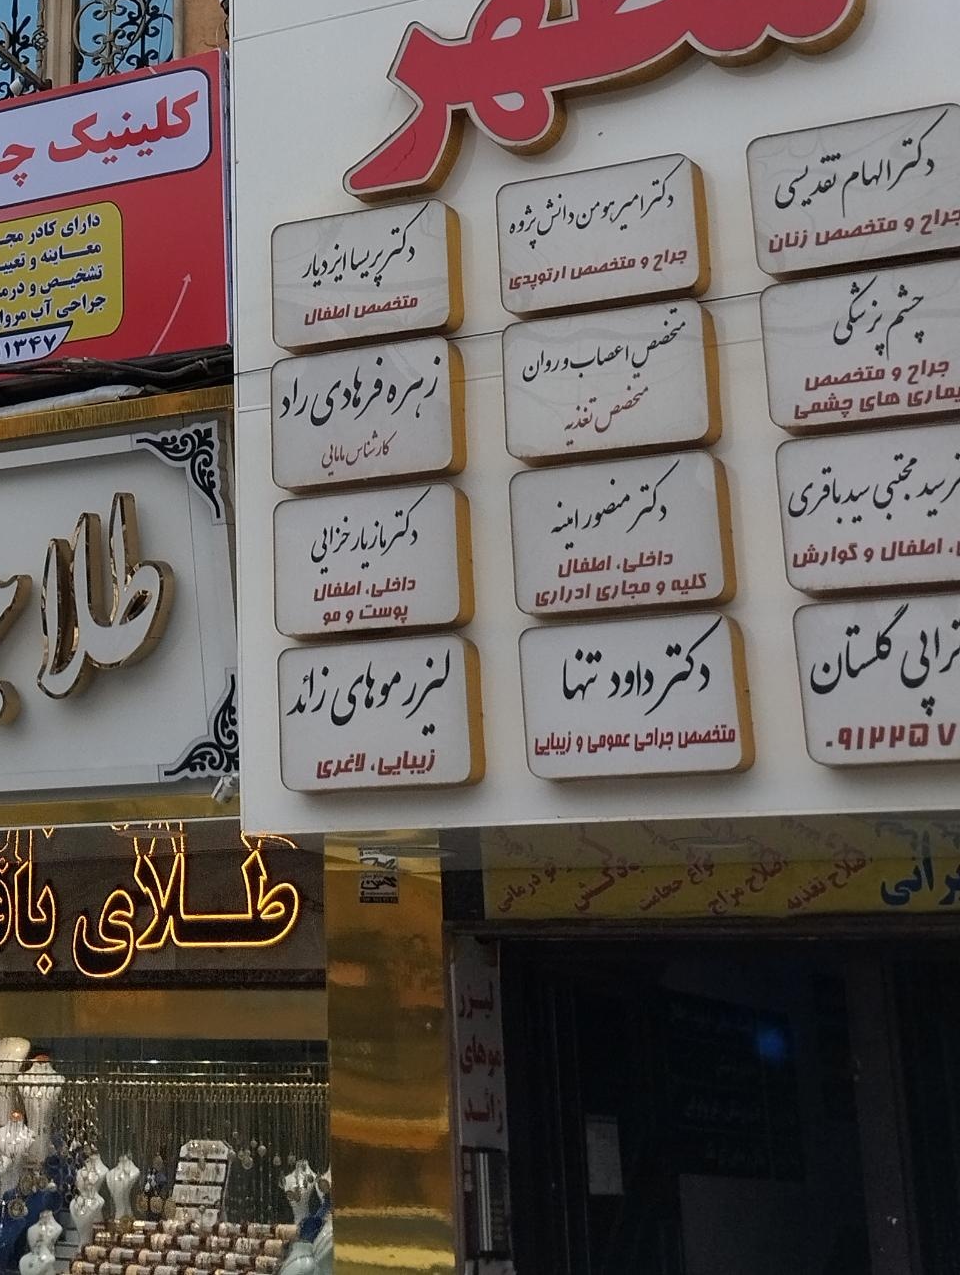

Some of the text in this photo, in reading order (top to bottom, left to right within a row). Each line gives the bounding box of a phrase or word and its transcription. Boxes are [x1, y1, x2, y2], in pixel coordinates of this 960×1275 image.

[48, 91, 199, 165] کلینیک
[775, 108, 948, 218] دکتر الهام تقدیسی
[640, 158, 685, 219] دکتر
[28, 221, 56, 240] کادر
[61, 213, 100, 237] دارای
[576, 200, 614, 230] هومن
[613, 193, 644, 231] امیر
[768, 207, 960, 253] جراح و متخصص زنان
[28, 256, 37, 270] و
[40, 241, 101, 263] معاینه
[302, 201, 429, 287] دکتر پریسا ایزدیار
[40, 265, 103, 294] تشخیص
[509, 249, 688, 291] جراح و متخصص ارتوپدی
[28, 283, 36, 297] و
[30, 298, 52, 321] آب
[56, 294, 106, 319] جراحی
[304, 294, 418, 326] متخصص اطفال
[833, 275, 924, 360] چشم پزشکی
[522, 307, 685, 382] متخصص اعصاب و روان
[280, 355, 440, 426] زهره فرهادی راد
[805, 359, 950, 392] جراح و متخصص
[564, 373, 649, 446] متخصص تغذیه
[794, 391, 900, 420] های چشمی
[321, 430, 397, 476] کارشناس مامایی
[581, 478, 630, 529] منصور
[626, 459, 680, 533] دکتر
[788, 466, 842, 524] باقری
[841, 485, 870, 524] سید
[873, 453, 917, 521] مجتبی
[916, 478, 946, 517] سید
[381, 486, 431, 556] دکتر
[351, 520, 387, 569] مازیار
[792, 542, 858, 568] گوارش
[863, 547, 874, 563] و
[881, 538, 942, 561] اطفال
[558, 555, 611, 578] اطفال
[38, 491, 175, 700] طلا
[314, 581, 361, 601] اطفال
[535, 573, 707, 607] کلیه و مجاری ادراری
[323, 605, 408, 625] پوست و مو
[562, 615, 723, 716] دکتر داود تنها
[811, 603, 909, 695] گلستان
[286, 649, 450, 736] لیزر موهای زائد
[534, 725, 736, 756] متخصص جراحی عمومی و زیبایی
[317, 753, 365, 779] لاغری
[73, 849, 300, 979] طلای
